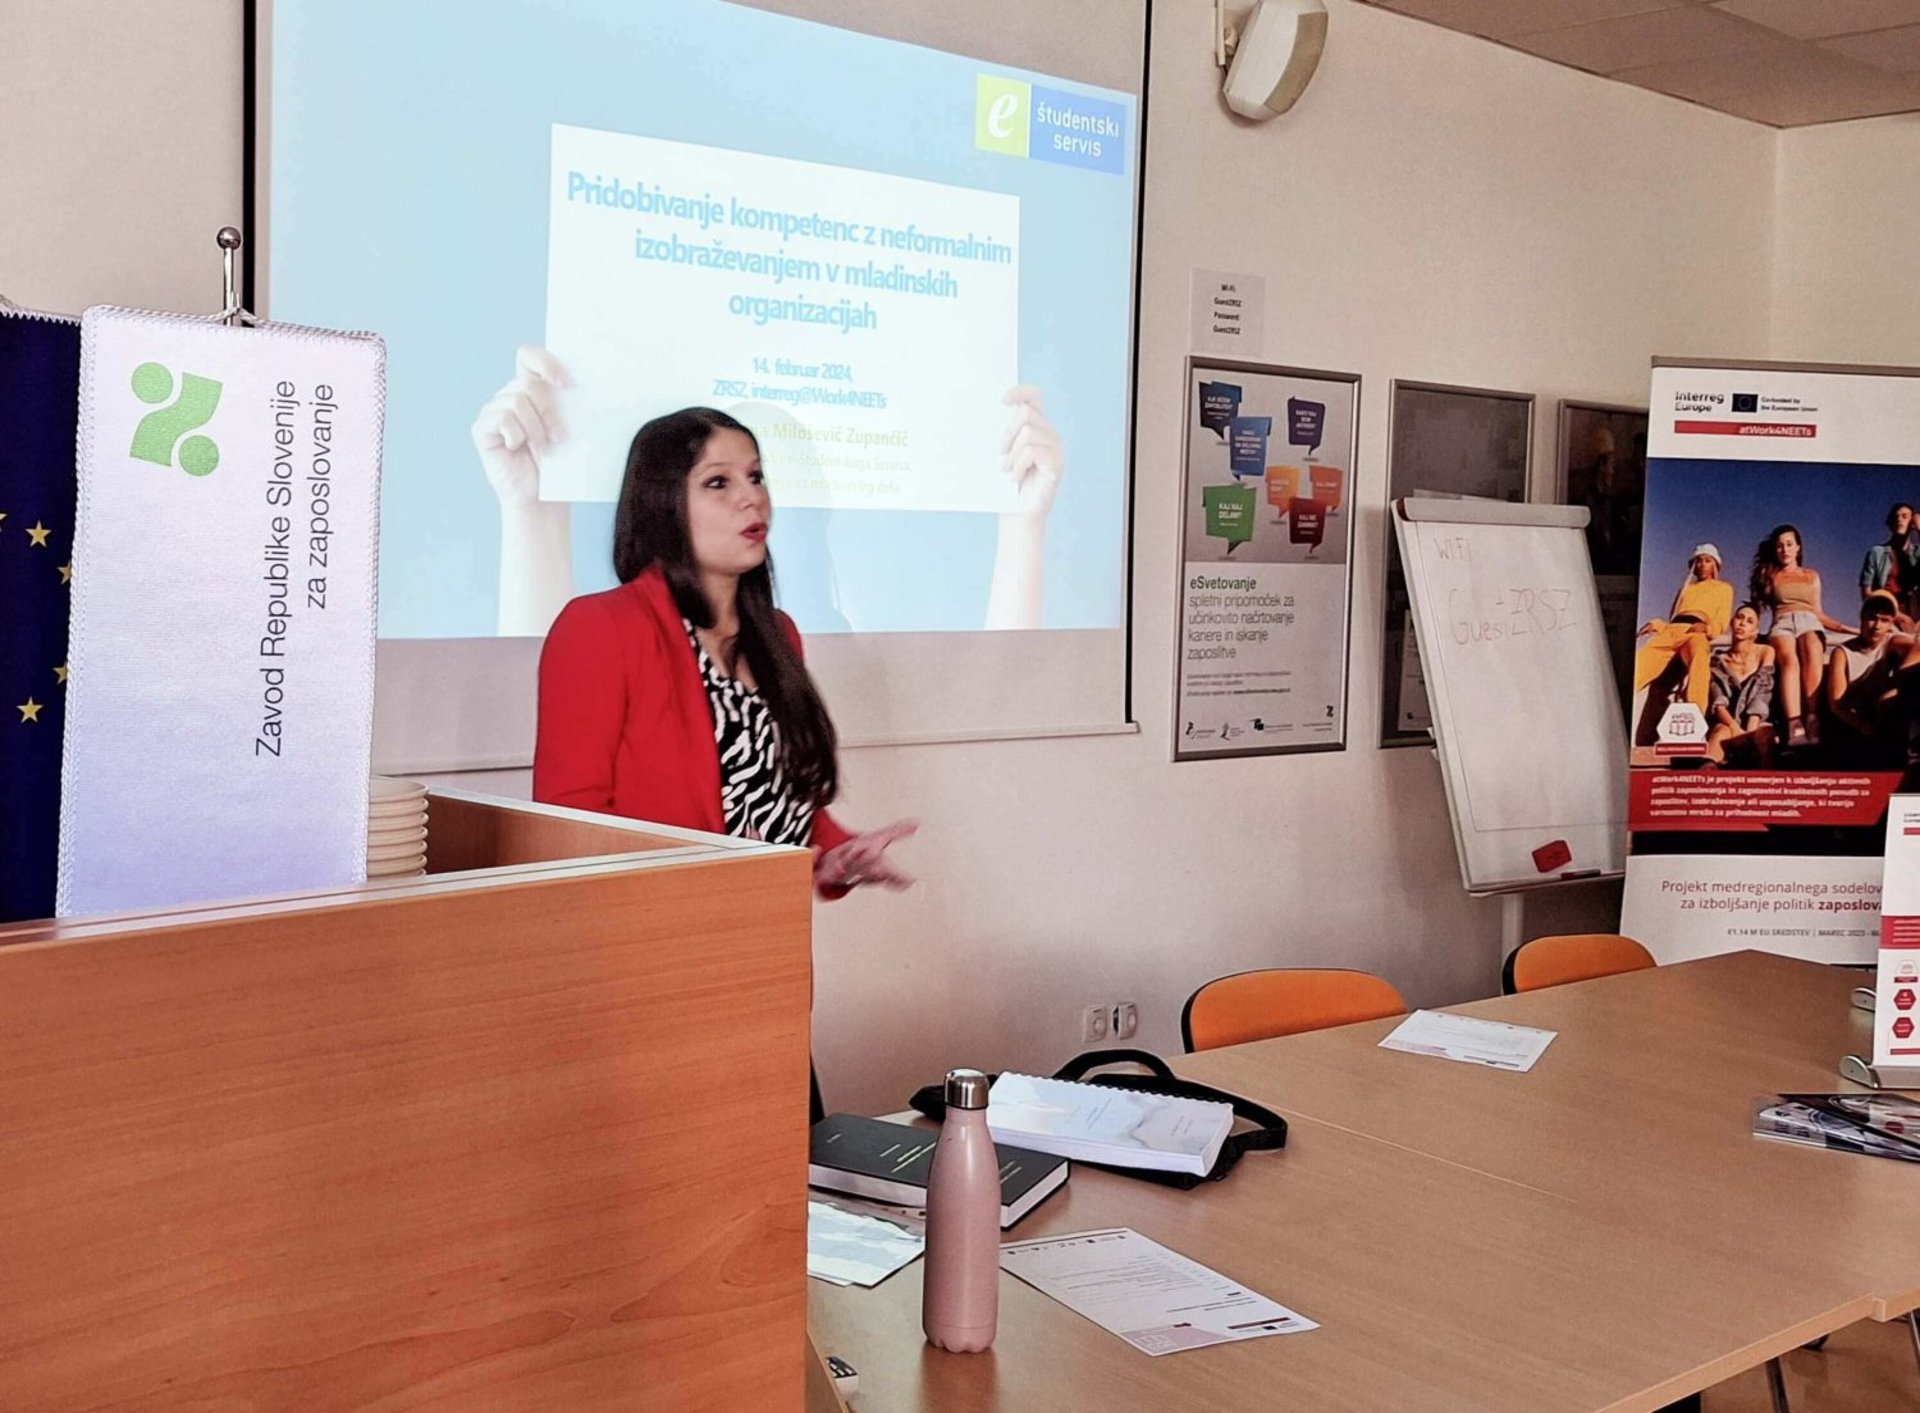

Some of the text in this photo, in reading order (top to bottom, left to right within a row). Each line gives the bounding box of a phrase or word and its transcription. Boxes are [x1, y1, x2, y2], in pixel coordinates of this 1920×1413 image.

[1036, 101, 1119, 138] študentski
[1053, 133, 1102, 157] servis
[568, 171, 1012, 264] Pridobivanje kompetenc z neformalnim
[635, 228, 958, 298] izobraževanjem v mladinskih
[729, 293, 878, 334] organizacijah
[752, 357, 770, 375] 14.
[775, 359, 820, 378] februar
[1675, 391, 1725, 404] Interreg
[1675, 402, 1712, 413] Europe
[1739, 424, 1813, 437] atWork4NEETs
[306, 384, 338, 610] za zaposlovanje
[256, 381, 301, 757] Zavod Republike Slovenije
[1190, 575, 1257, 592] eSvetovanje
[1189, 593, 1295, 610] spletni pripomoček za
[1188, 610, 1295, 625] učinkovito načrtovanje
[1188, 627, 1269, 643] kariere in iskanje
[1187, 646, 1236, 661] zaposlitve
[1661, 880, 1708, 895] Projekt
[1711, 881, 1828, 896] medregionalnega
[1680, 899, 1696, 910] za
[1699, 897, 1770, 913] izboljšanje
[1773, 898, 1815, 912] politik
